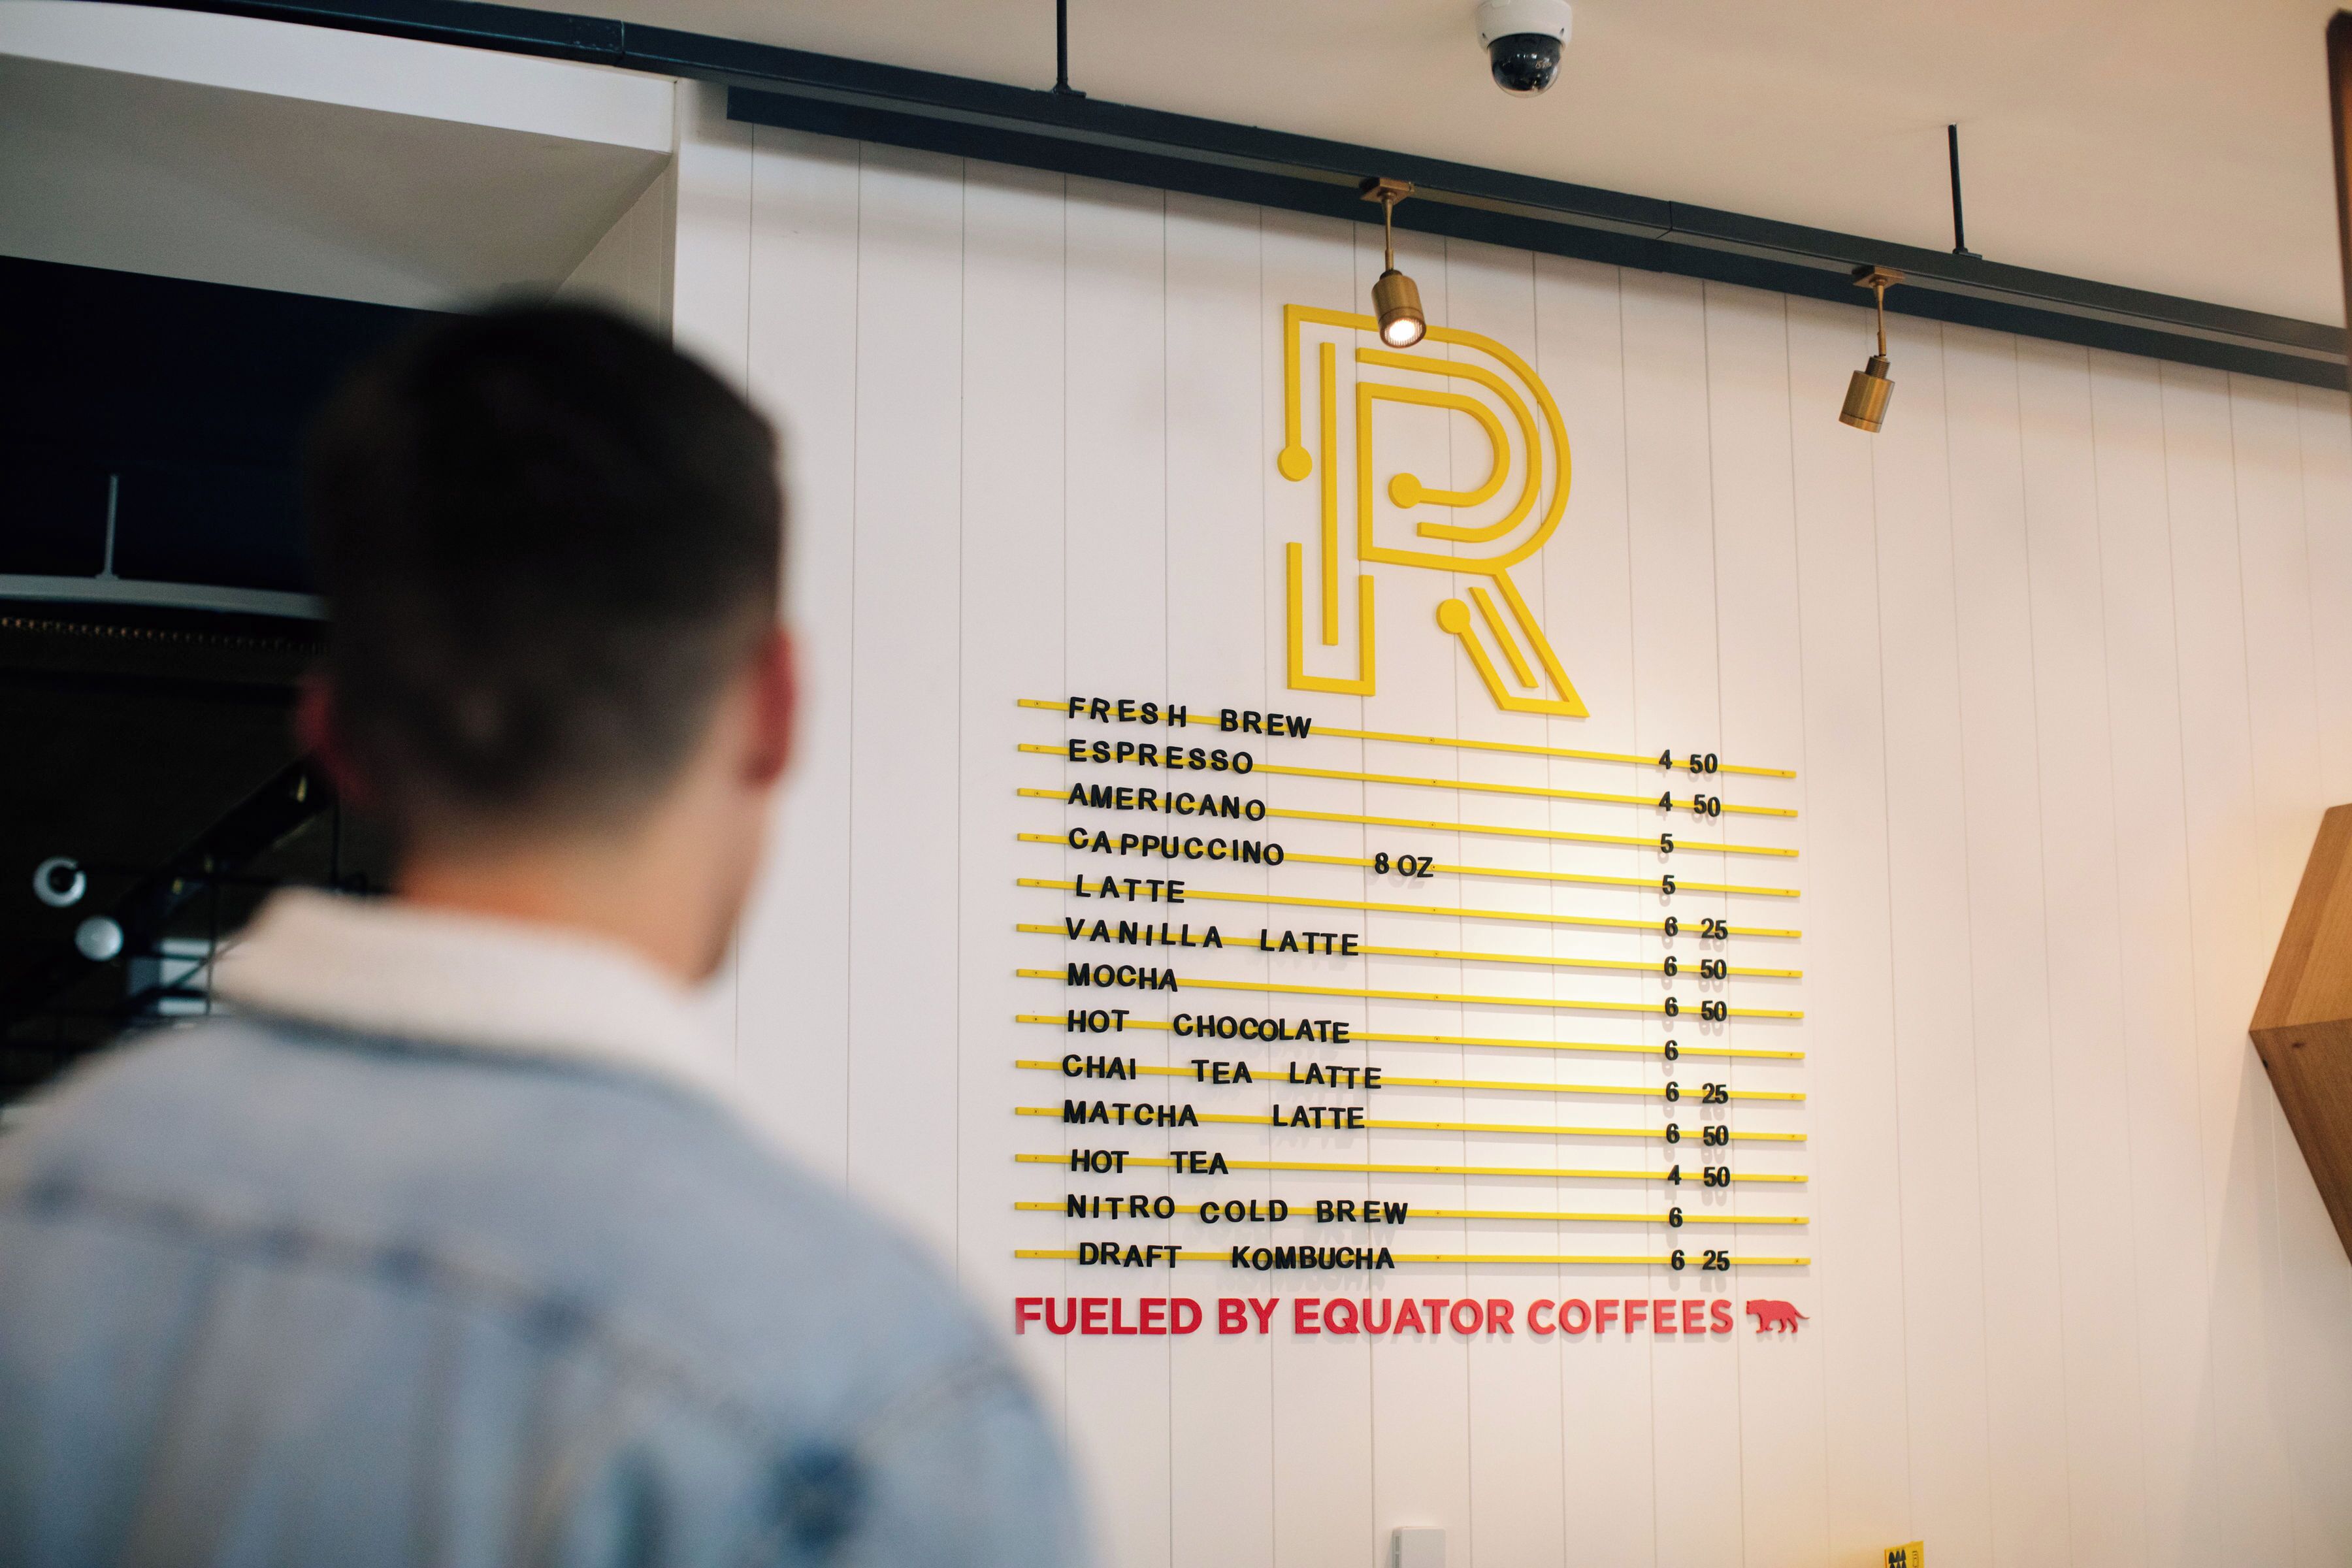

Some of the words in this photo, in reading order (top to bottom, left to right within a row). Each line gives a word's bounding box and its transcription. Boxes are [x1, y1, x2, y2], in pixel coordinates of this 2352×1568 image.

[1278, 304, 1590, 717] R
[1068, 696, 1187, 727] FRESH
[1221, 709, 1311, 738] BREW
[1659, 749, 1673, 770] 4
[1690, 753, 1718, 774] 50
[1069, 739, 1253, 774] ESPRESSO
[1659, 792, 1673, 811] 4
[1693, 794, 1720, 817] 50
[1068, 783, 1266, 821] AMERICANO
[1661, 833, 1673, 853] 5
[1068, 827, 1284, 866] CAPPUCCINO
[1375, 853, 1389, 874] 8
[1397, 855, 1434, 877] OZ
[1662, 875, 1675, 894] 5
[1076, 874, 1184, 903] LATTE
[1665, 916, 1678, 937] 6
[1701, 918, 1728, 939] 25
[1066, 917, 1223, 948] VANILLA
[1260, 929, 1358, 956] LATTE
[1664, 956, 1677, 976] 6
[1701, 959, 1727, 979] 50
[1068, 962, 1177, 992] MOCHA
[1665, 996, 1678, 1017] 6
[1701, 1000, 1727, 1021] 50
[1068, 1009, 1129, 1033] HOT
[1173, 1013, 1349, 1044] CHOCOLATE
[1665, 1040, 1678, 1060] 6
[1062, 1054, 1136, 1080] CHAI
[1191, 1060, 1252, 1085] TEA
[1290, 1062, 1382, 1089] LATTE
[1666, 1082, 1680, 1102] 6
[1702, 1083, 1728, 1104] 25
[1063, 1100, 1198, 1127] MATCHA
[1273, 1104, 1364, 1129] LATTE
[1666, 1124, 1680, 1143] 6
[1703, 1126, 1729, 1147] 50
[1071, 1149, 1129, 1173] HOT
[1170, 1151, 1228, 1175] TEA
[1667, 1165, 1681, 1185] 4
[1703, 1167, 1730, 1187] 50
[1068, 1194, 1175, 1219] NITRO
[1200, 1200, 1288, 1224] COLD
[1317, 1200, 1408, 1224] BREW
[1669, 1207, 1682, 1228] 6
[1079, 1242, 1182, 1268] DRAFT
[1231, 1245, 1395, 1271] KOMBUCHA
[1671, 1250, 1685, 1270] 6
[1703, 1250, 1730, 1271] 25
[1015, 1298, 1202, 1335] FUELED
[1218, 1298, 1279, 1334] BY
[1294, 1298, 1514, 1334] EQUATOR
[1527, 1298, 1733, 1334] COFFEES
